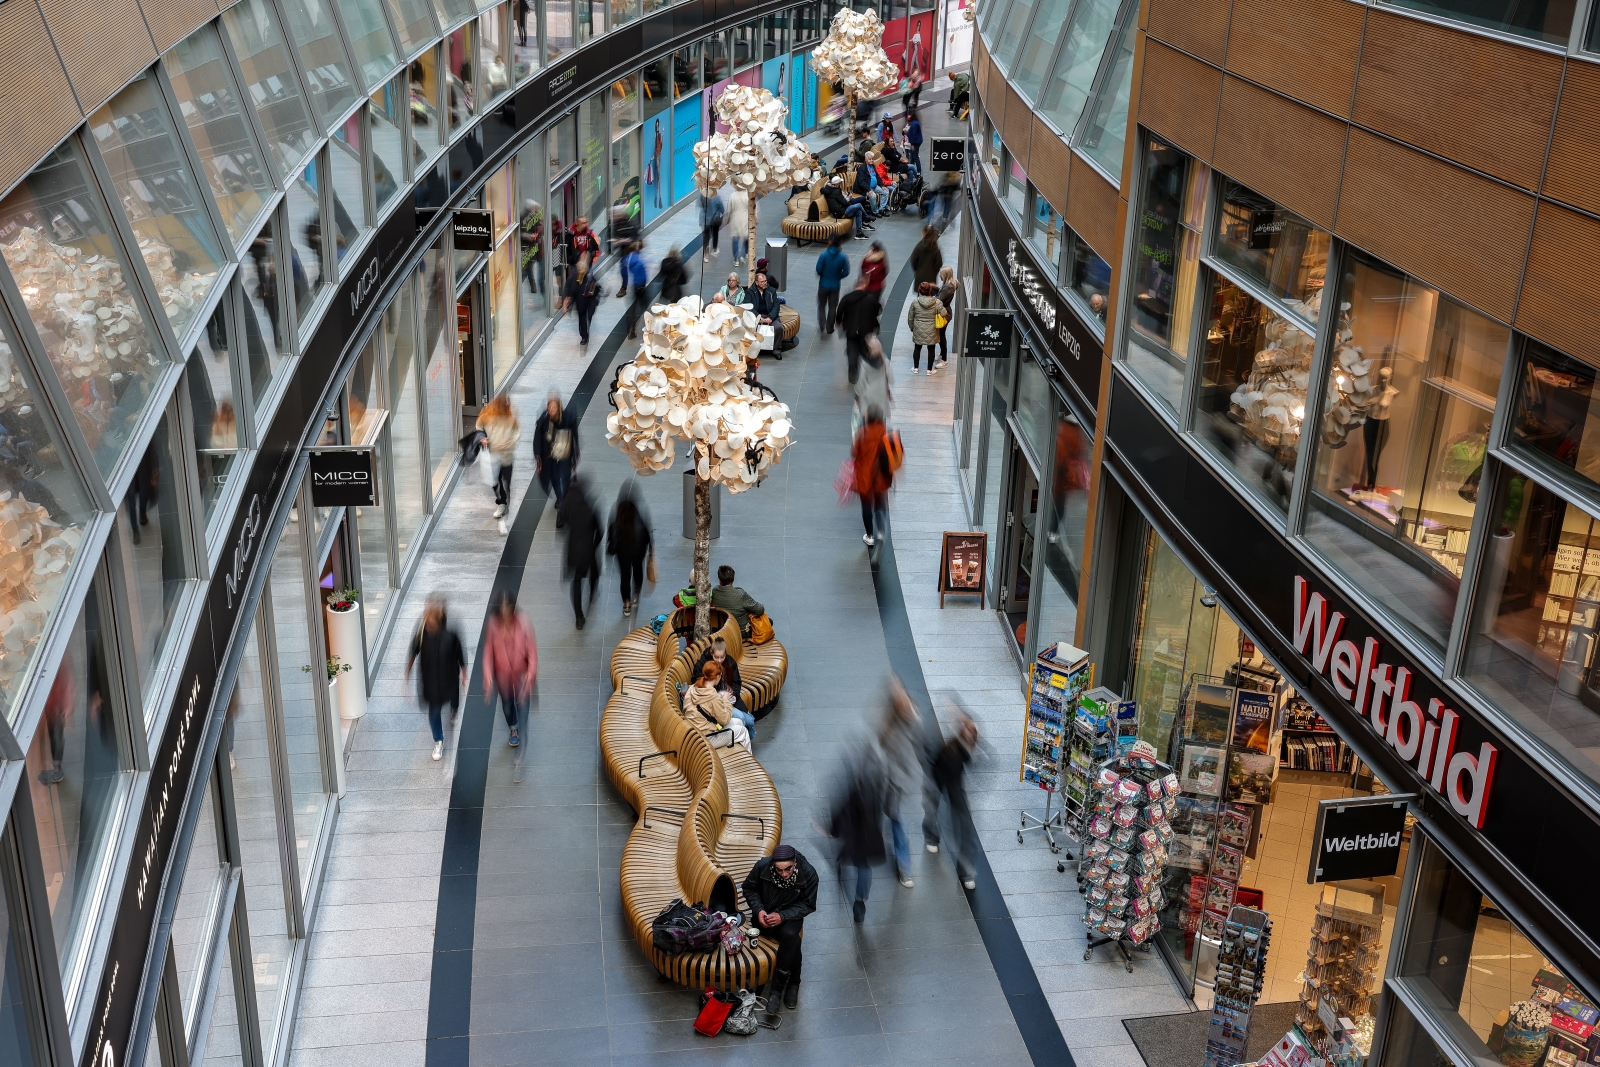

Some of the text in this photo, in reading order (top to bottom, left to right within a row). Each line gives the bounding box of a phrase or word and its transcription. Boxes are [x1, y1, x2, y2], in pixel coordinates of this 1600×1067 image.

[933, 151, 964, 160] zero
[350, 256, 379, 317] MICO
[1058, 321, 1081, 361] LEIPZIG
[314, 471, 368, 481] MICO
[225, 493, 261, 609] MICO
[185, 674, 201, 731] BOWL
[1240, 703, 1270, 716] NATUR
[1293, 575, 1497, 830] Weltbild
[1325, 831, 1401, 853] Weltbild
